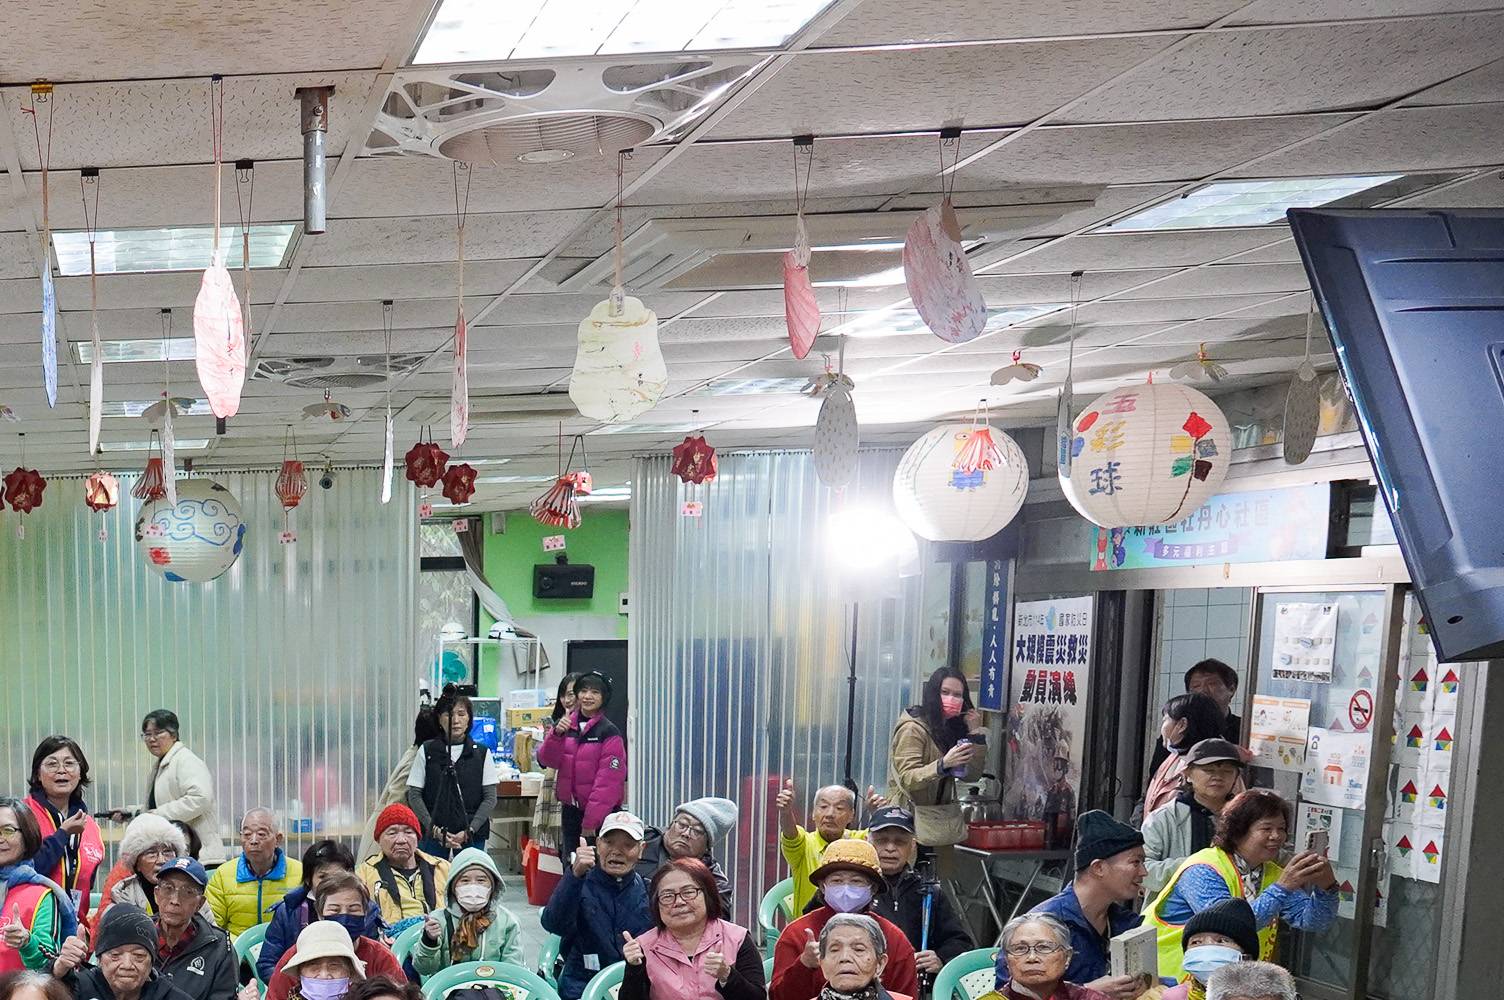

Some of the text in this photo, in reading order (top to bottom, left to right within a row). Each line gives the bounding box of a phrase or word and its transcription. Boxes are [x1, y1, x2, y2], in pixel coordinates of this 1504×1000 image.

[1088, 393, 1140, 496] 五彩球
[1015, 634, 1089, 666] 大規模震災救災
